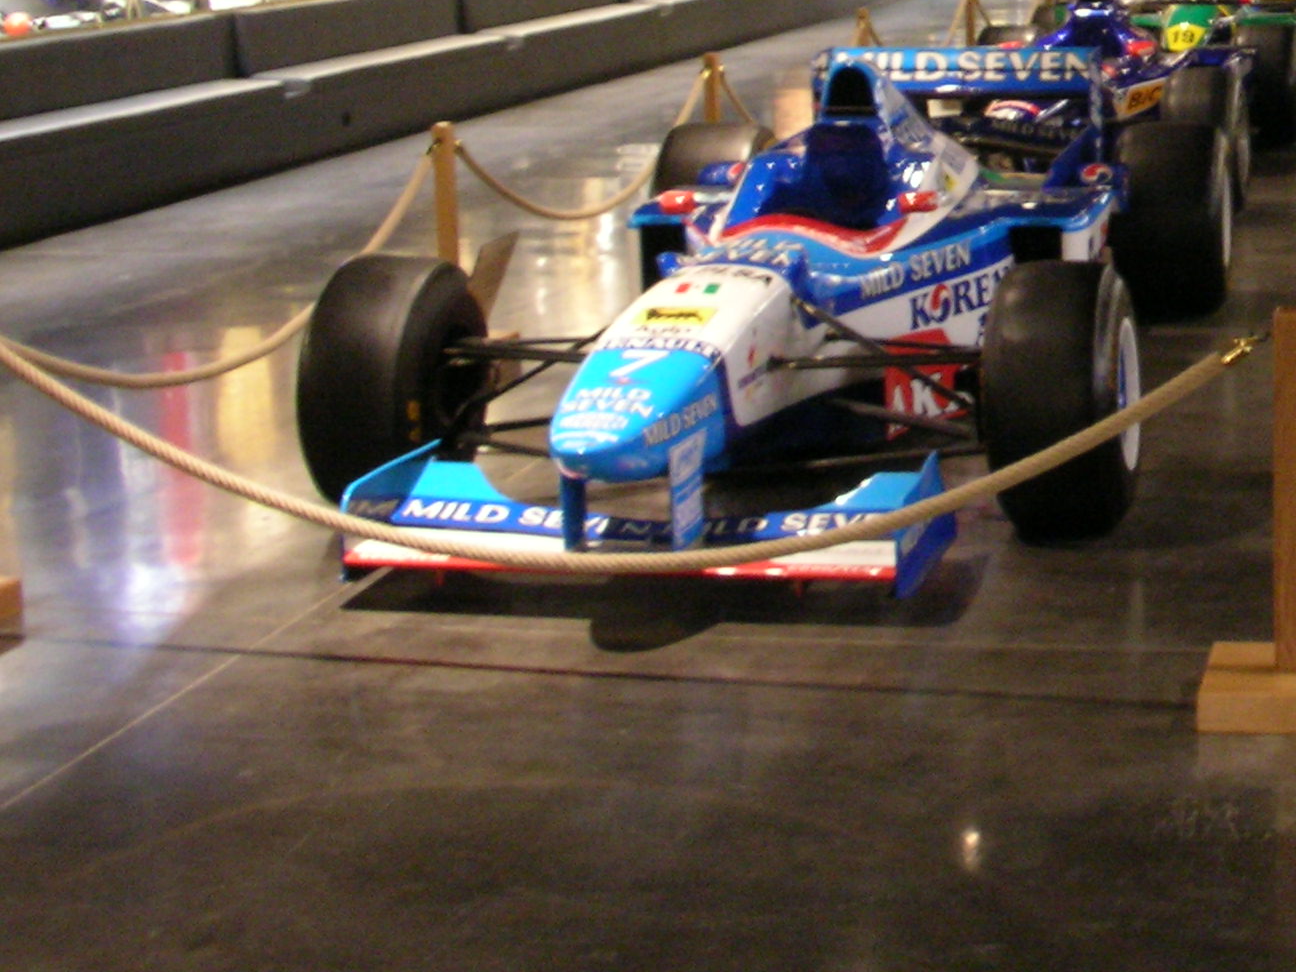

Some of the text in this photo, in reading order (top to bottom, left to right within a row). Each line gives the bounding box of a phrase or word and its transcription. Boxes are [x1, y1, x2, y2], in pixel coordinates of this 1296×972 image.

[957, 49, 1090, 82] SEVEN
[861, 239, 971, 299] MILD SEVEN
[608, 349, 670, 378] 7
[401, 498, 511, 525] MILD
